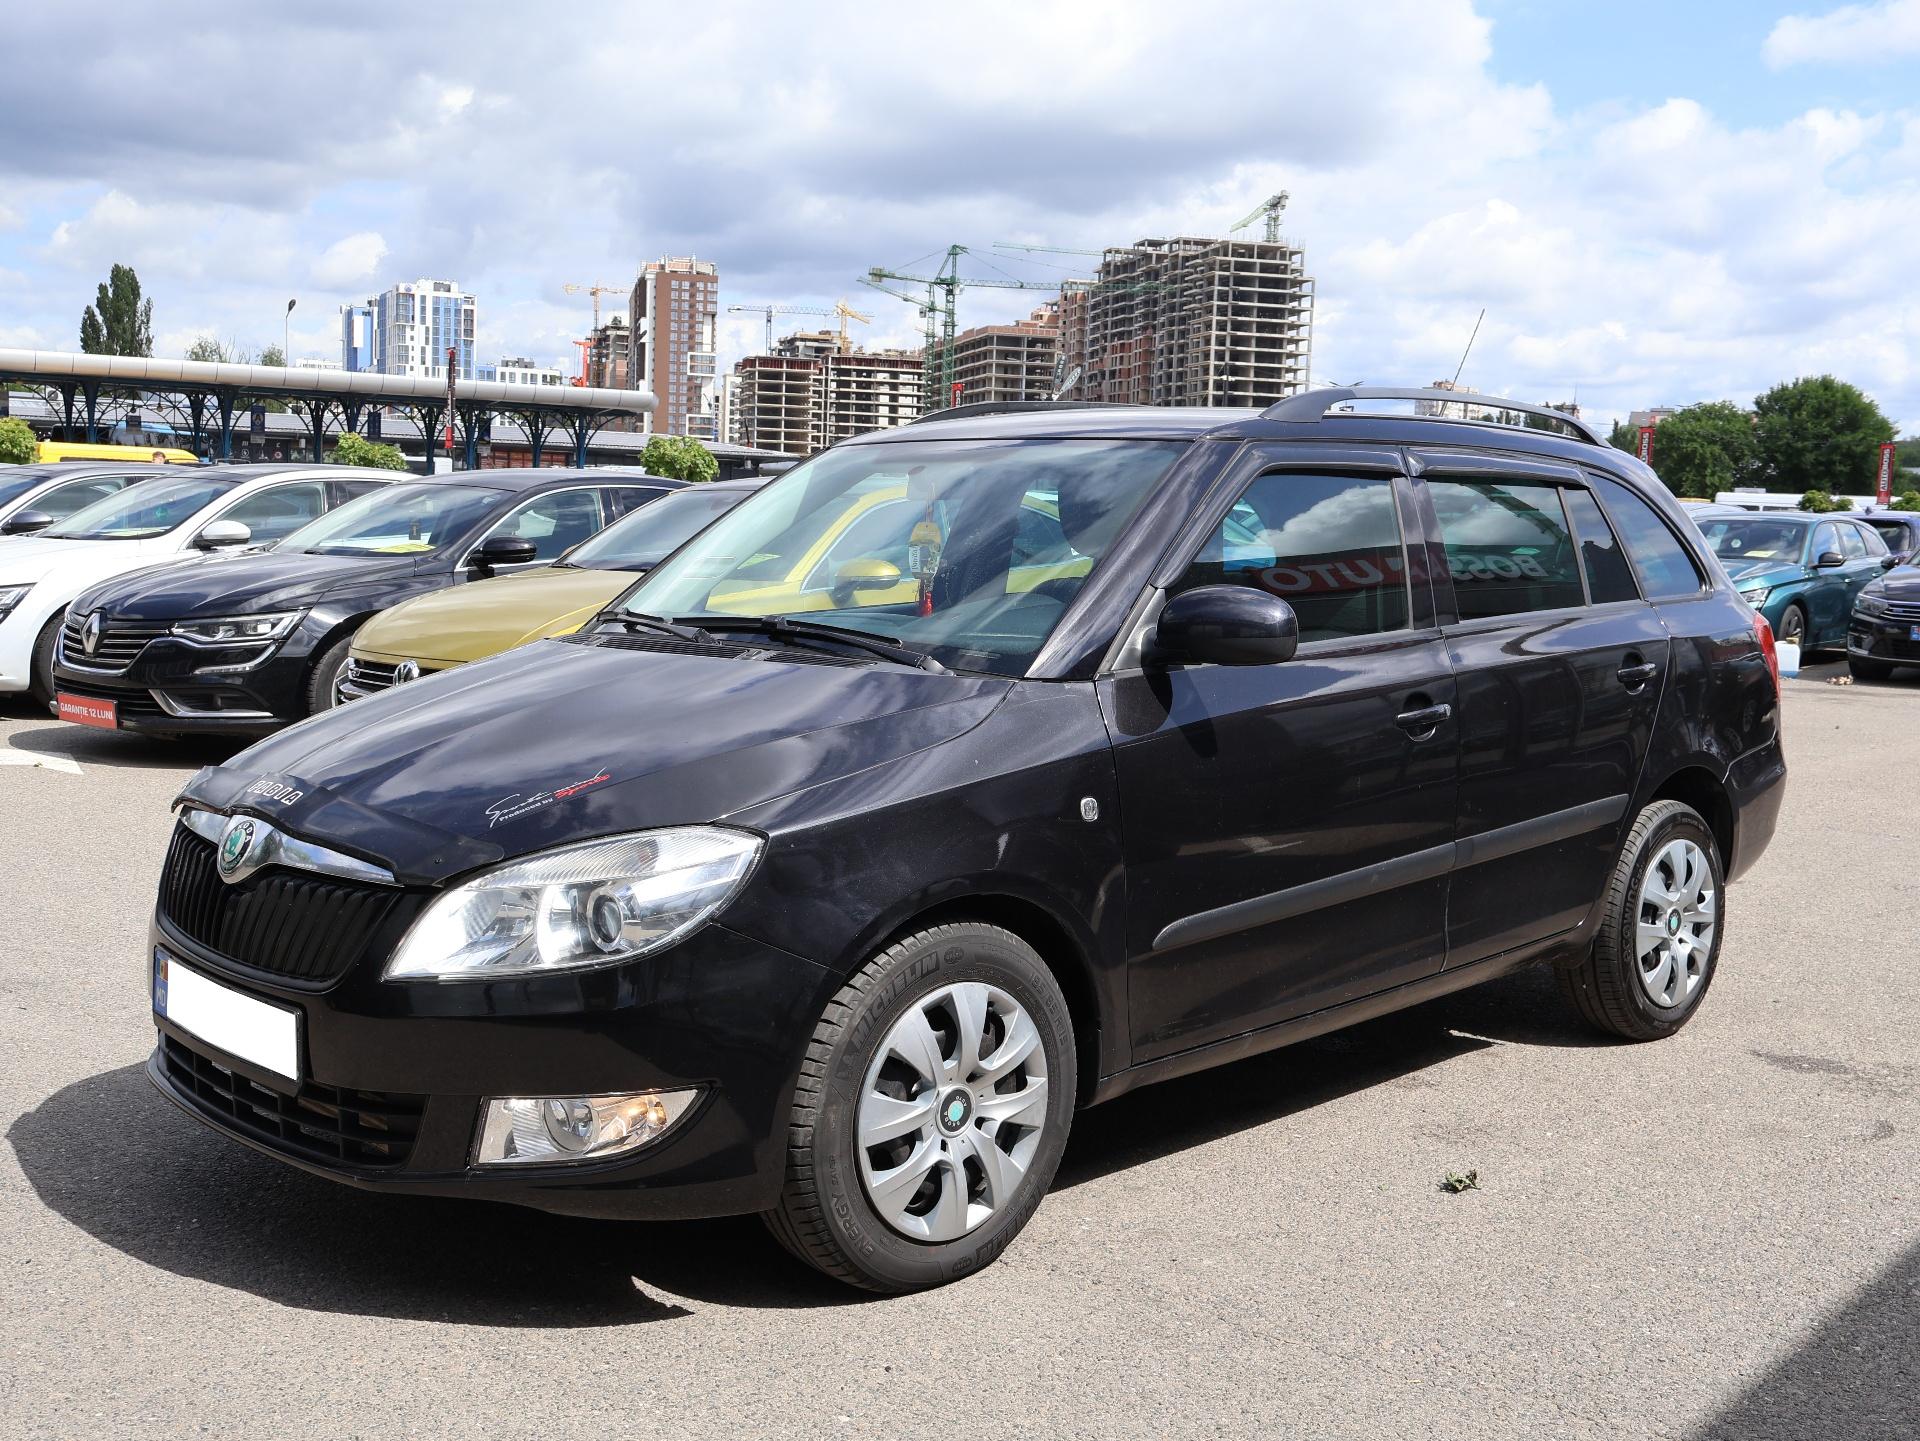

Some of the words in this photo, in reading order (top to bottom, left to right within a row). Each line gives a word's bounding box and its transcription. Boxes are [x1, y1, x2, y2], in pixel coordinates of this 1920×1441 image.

[88, 707, 97, 717] 12
[97, 709, 113, 720] LUNI
[247, 780, 304, 805] FABIA
[156, 984, 166, 1008] MD
[851, 951, 938, 1050] MICHELIN
